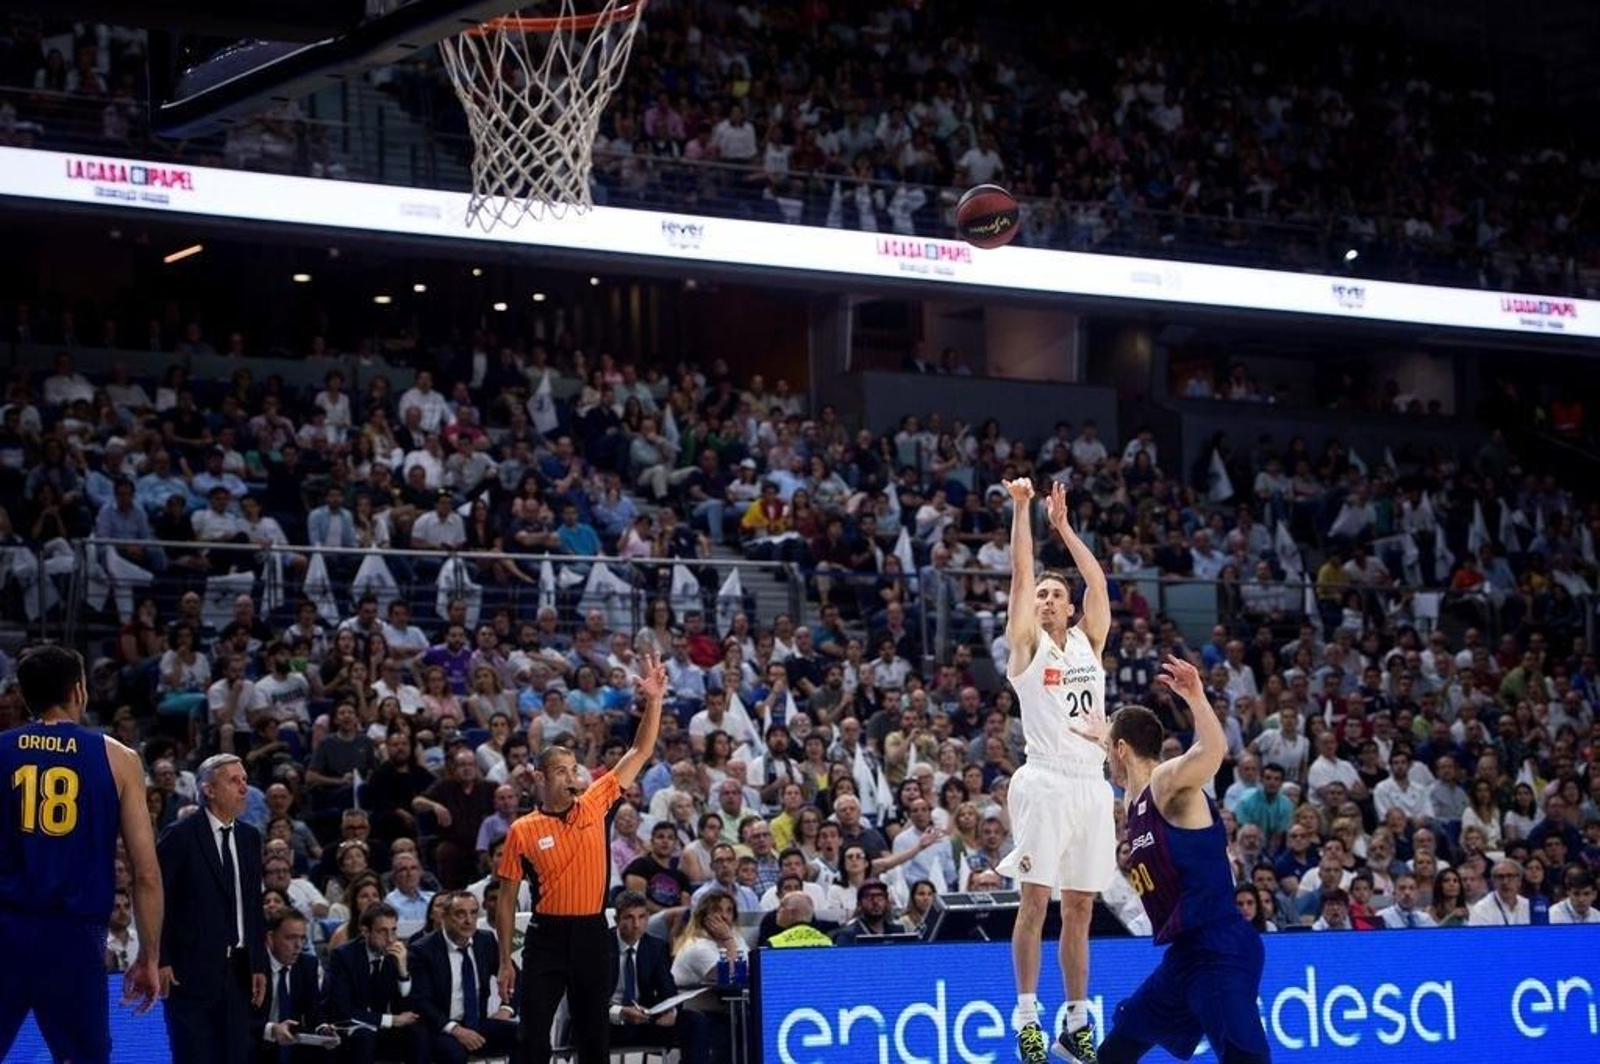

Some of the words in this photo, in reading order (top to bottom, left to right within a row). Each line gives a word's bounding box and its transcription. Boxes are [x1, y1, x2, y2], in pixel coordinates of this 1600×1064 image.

[1066, 689, 1093, 718] 20
[18, 734, 77, 754] ORIOLA
[12, 764, 80, 836] 18
